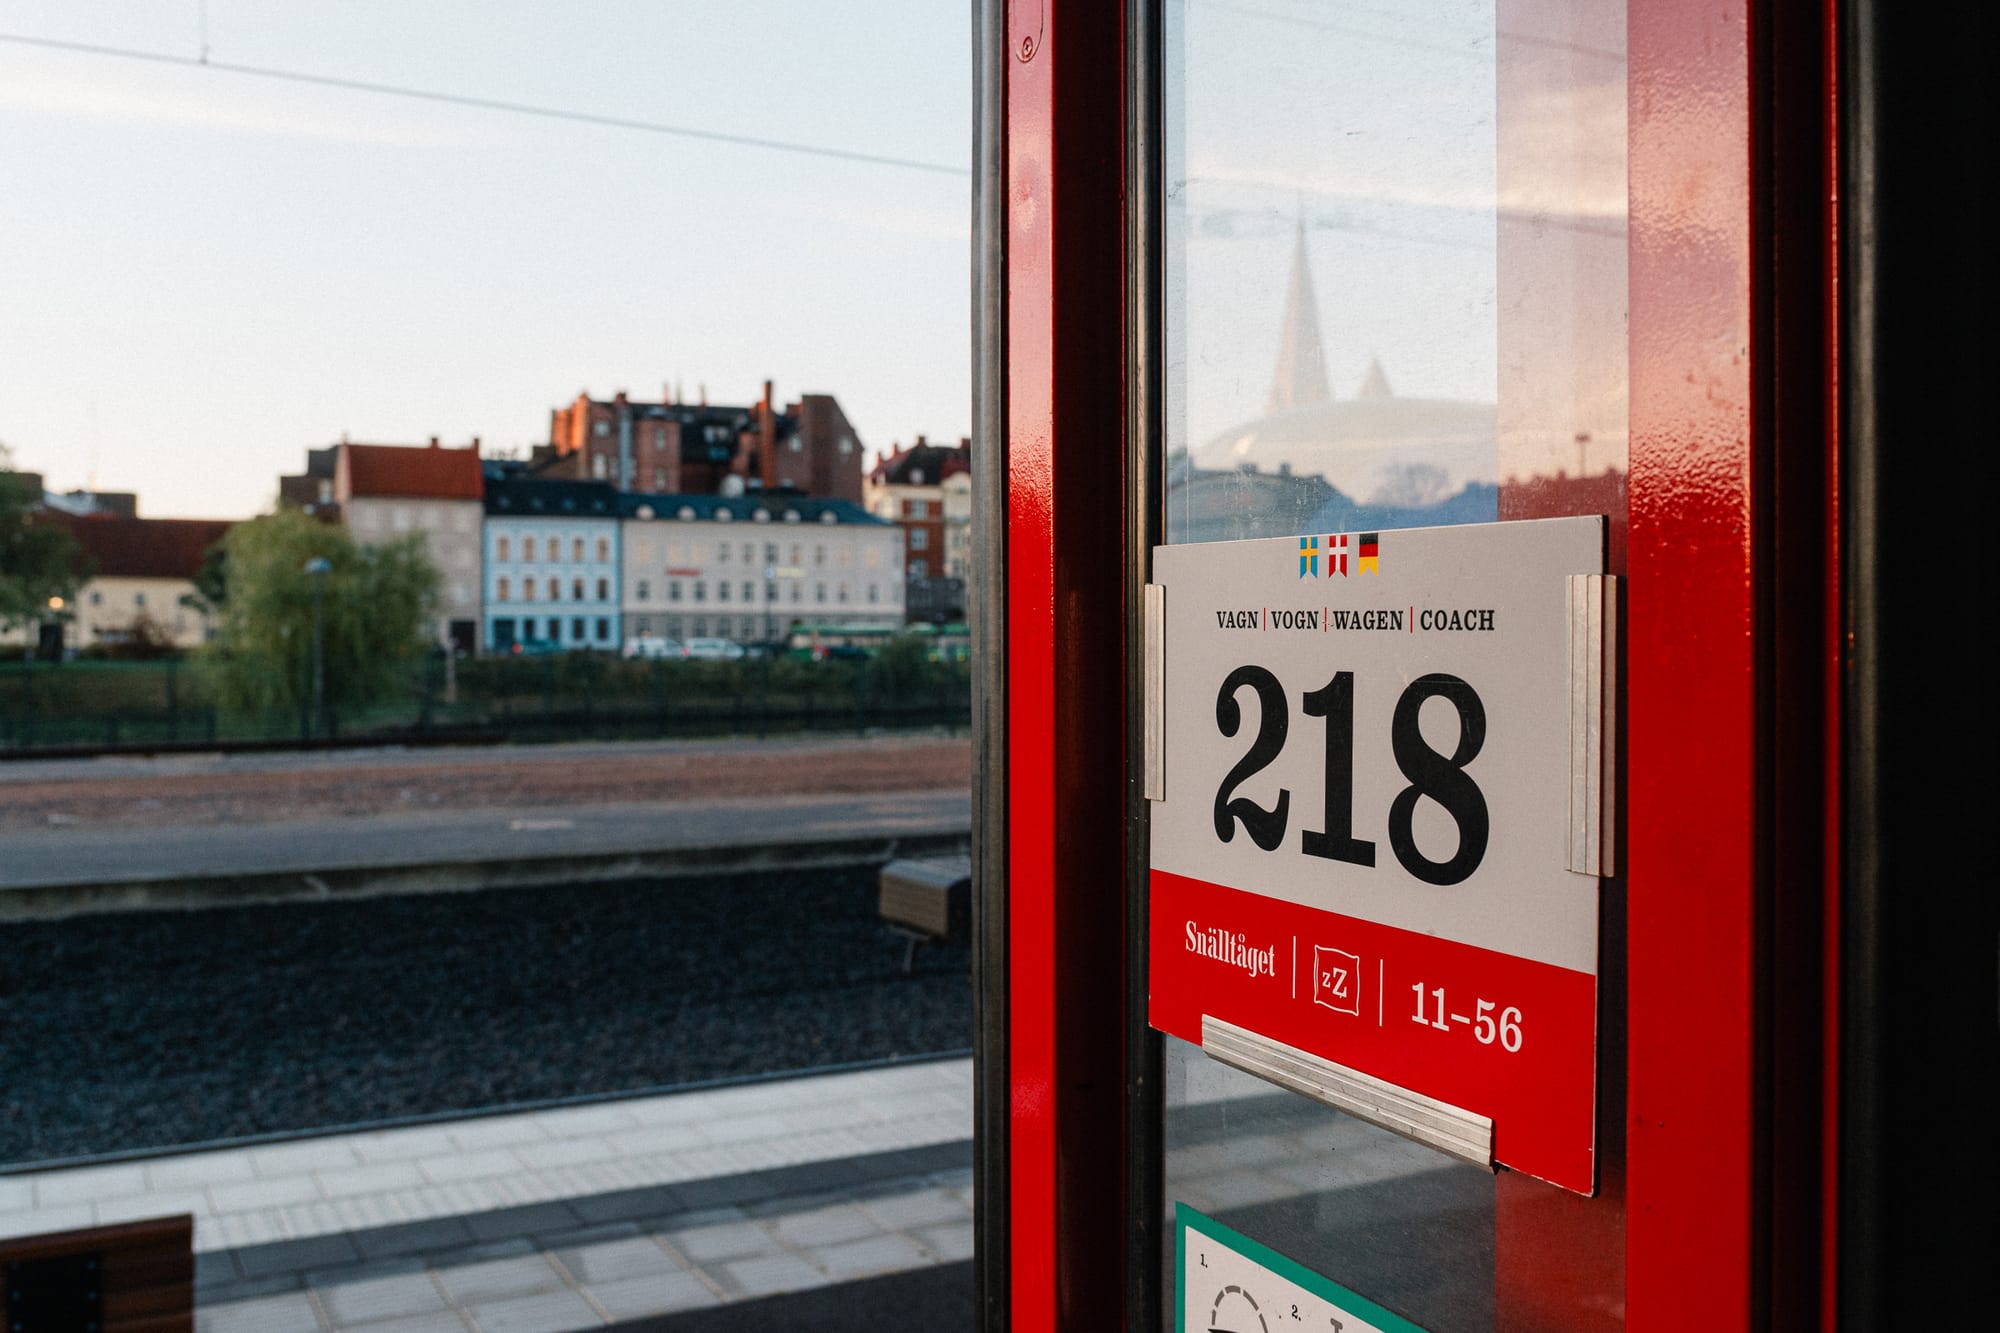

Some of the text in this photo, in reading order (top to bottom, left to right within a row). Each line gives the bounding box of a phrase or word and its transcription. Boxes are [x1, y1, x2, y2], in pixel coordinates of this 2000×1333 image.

[1216, 609, 1495, 631] VAGN VOGN WAGEN COACH
[1214, 664, 1489, 886] 218
[1185, 920, 1276, 977] Snälltåget
[1200, 1253, 1208, 1268] 1.
[1291, 1304, 1302, 1321] 2.
